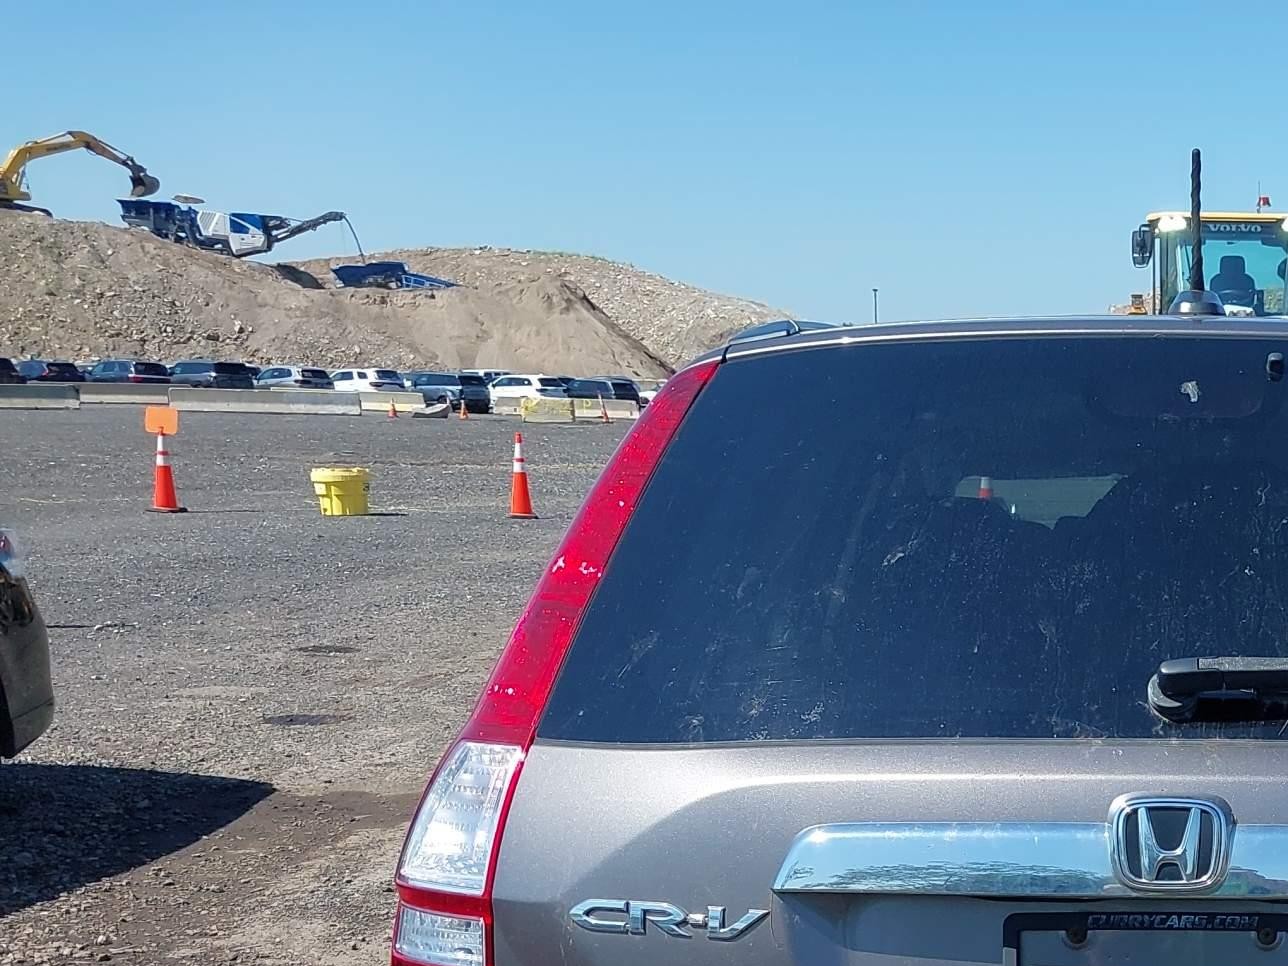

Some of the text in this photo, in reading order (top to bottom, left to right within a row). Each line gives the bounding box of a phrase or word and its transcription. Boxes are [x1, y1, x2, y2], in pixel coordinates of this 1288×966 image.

[1208, 223, 1262, 232] VOLVO
[568, 898, 771, 942] CR-V
[1087, 914, 1259, 929] CURRYCARS.COM
